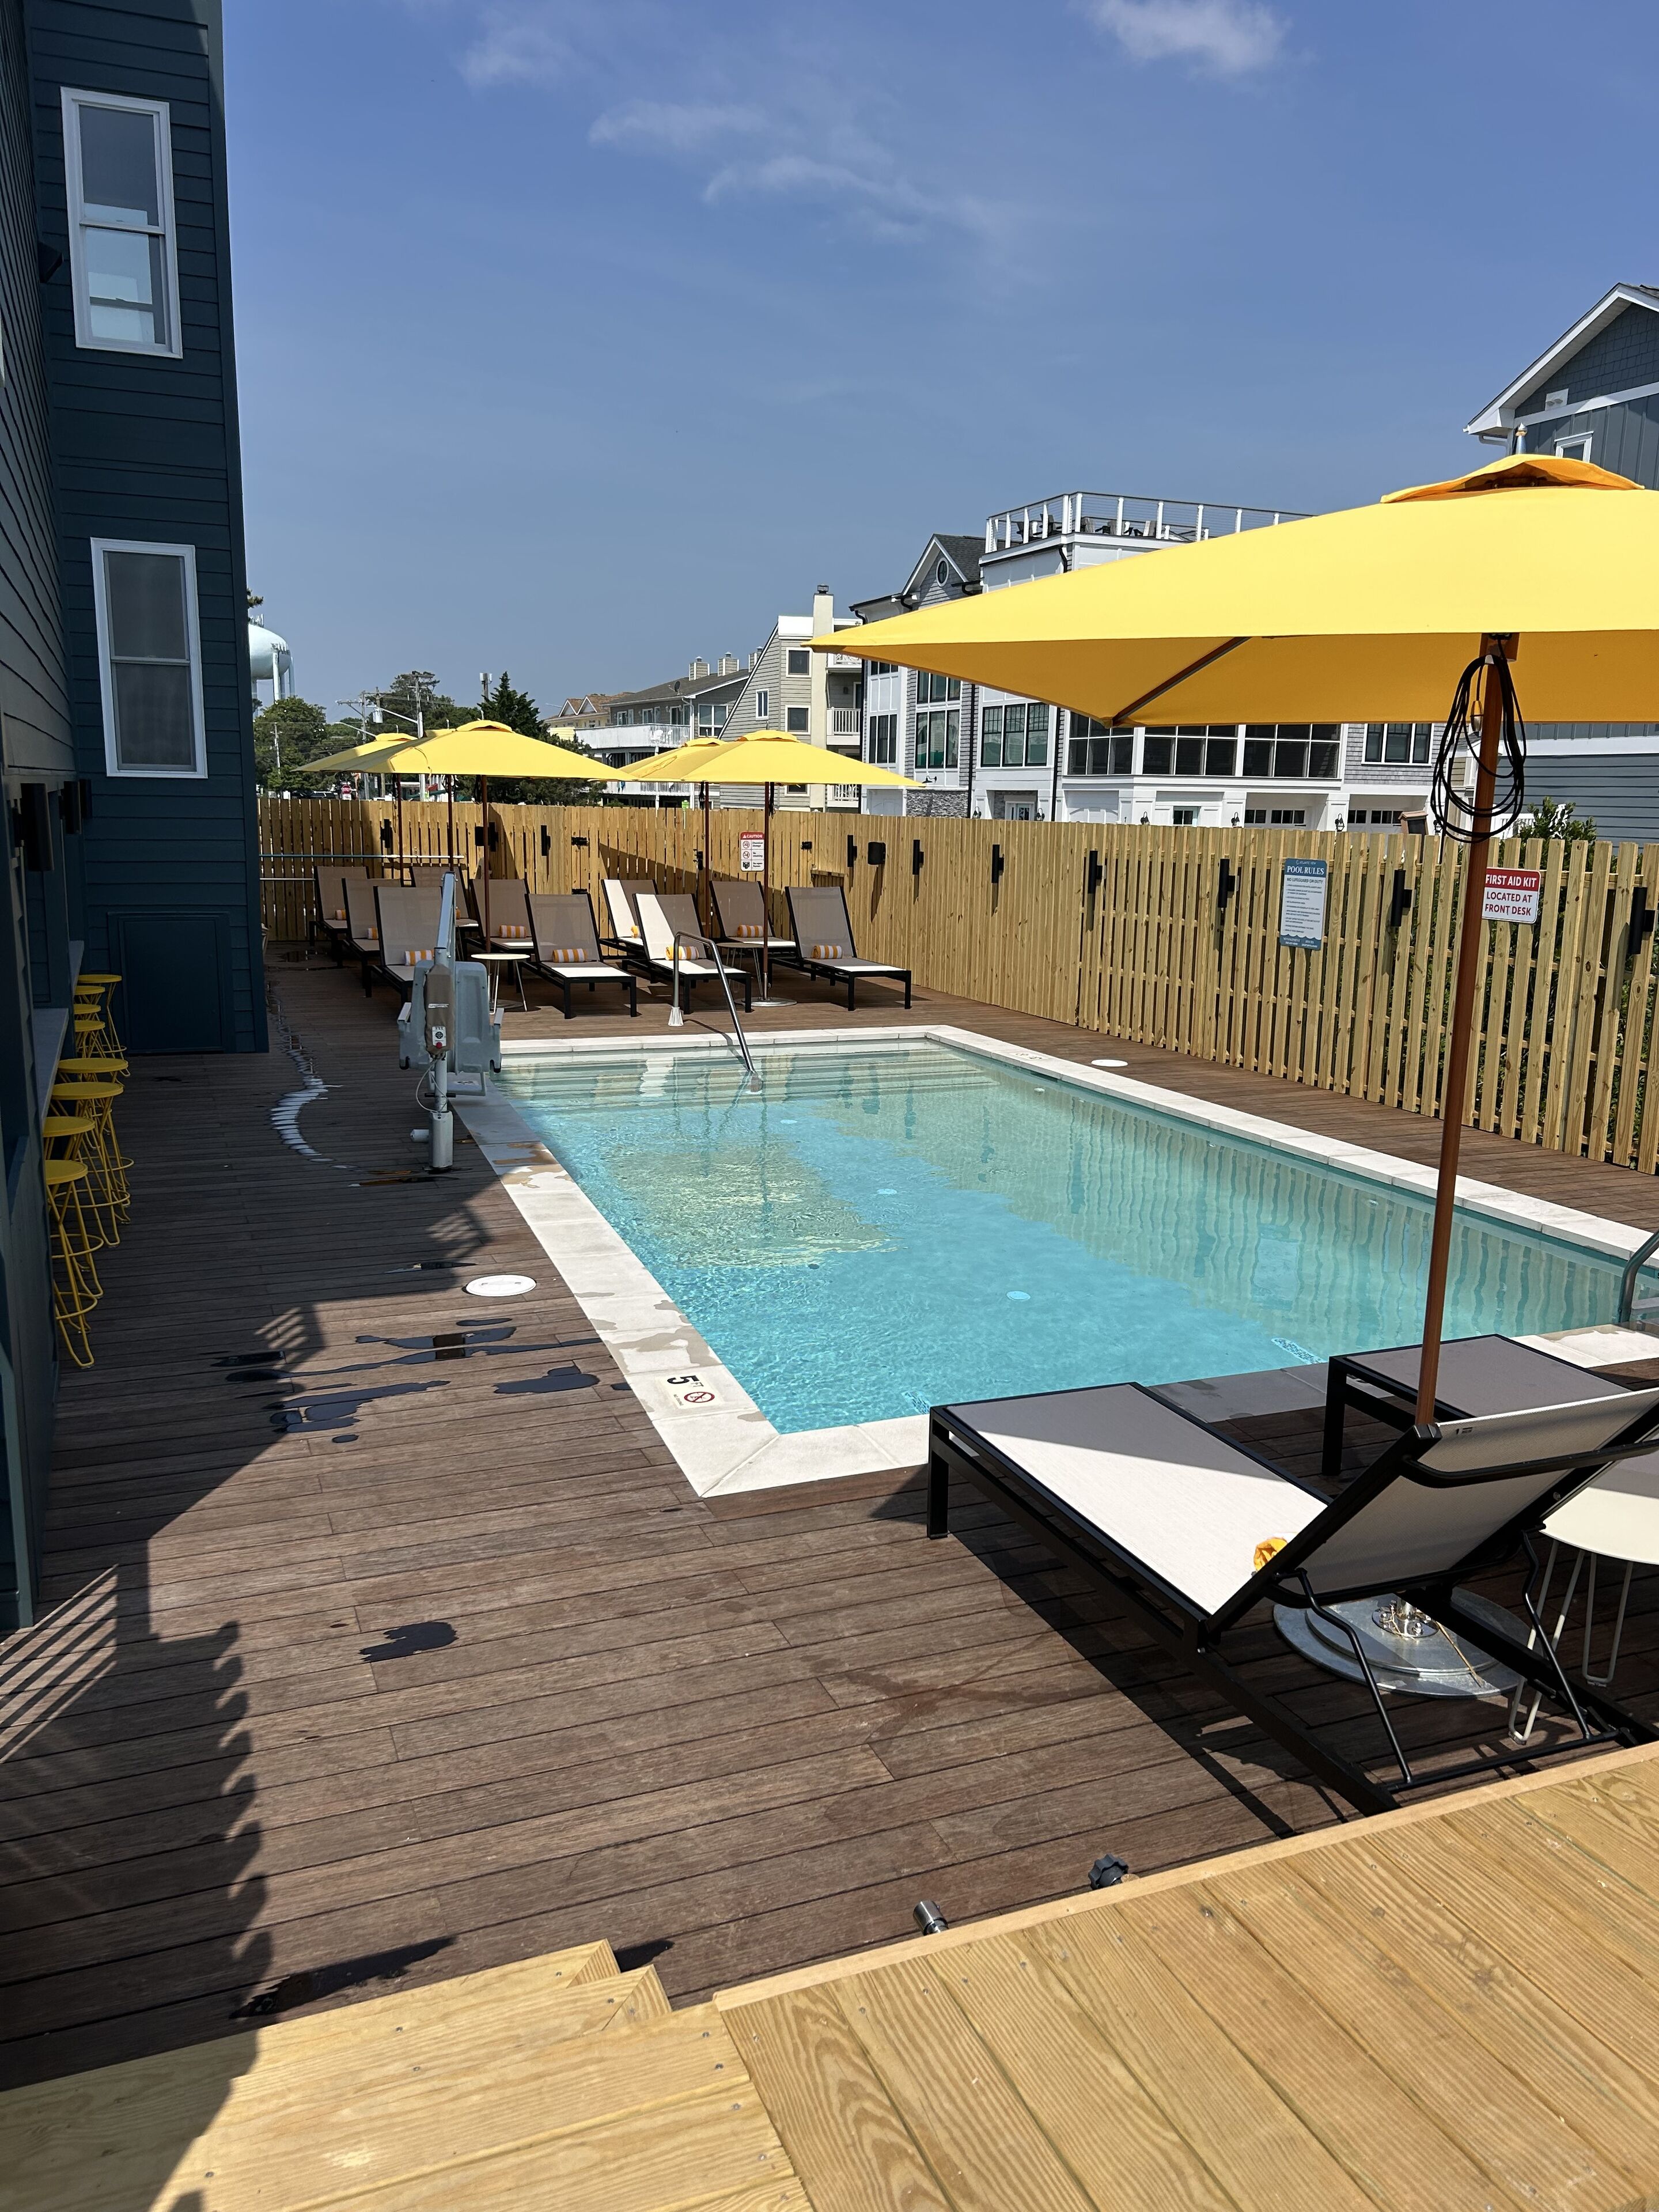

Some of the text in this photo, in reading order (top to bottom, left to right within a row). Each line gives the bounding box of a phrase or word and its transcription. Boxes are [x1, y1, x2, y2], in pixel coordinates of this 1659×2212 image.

[1304, 867, 1324, 875] RULES
[1486, 874, 1537, 888] FIRST AID KIT
[1487, 891, 1532, 903] LOCATED AT
[1484, 904, 1532, 916] FRONT DESK
[667, 1375, 699, 1384] 5
